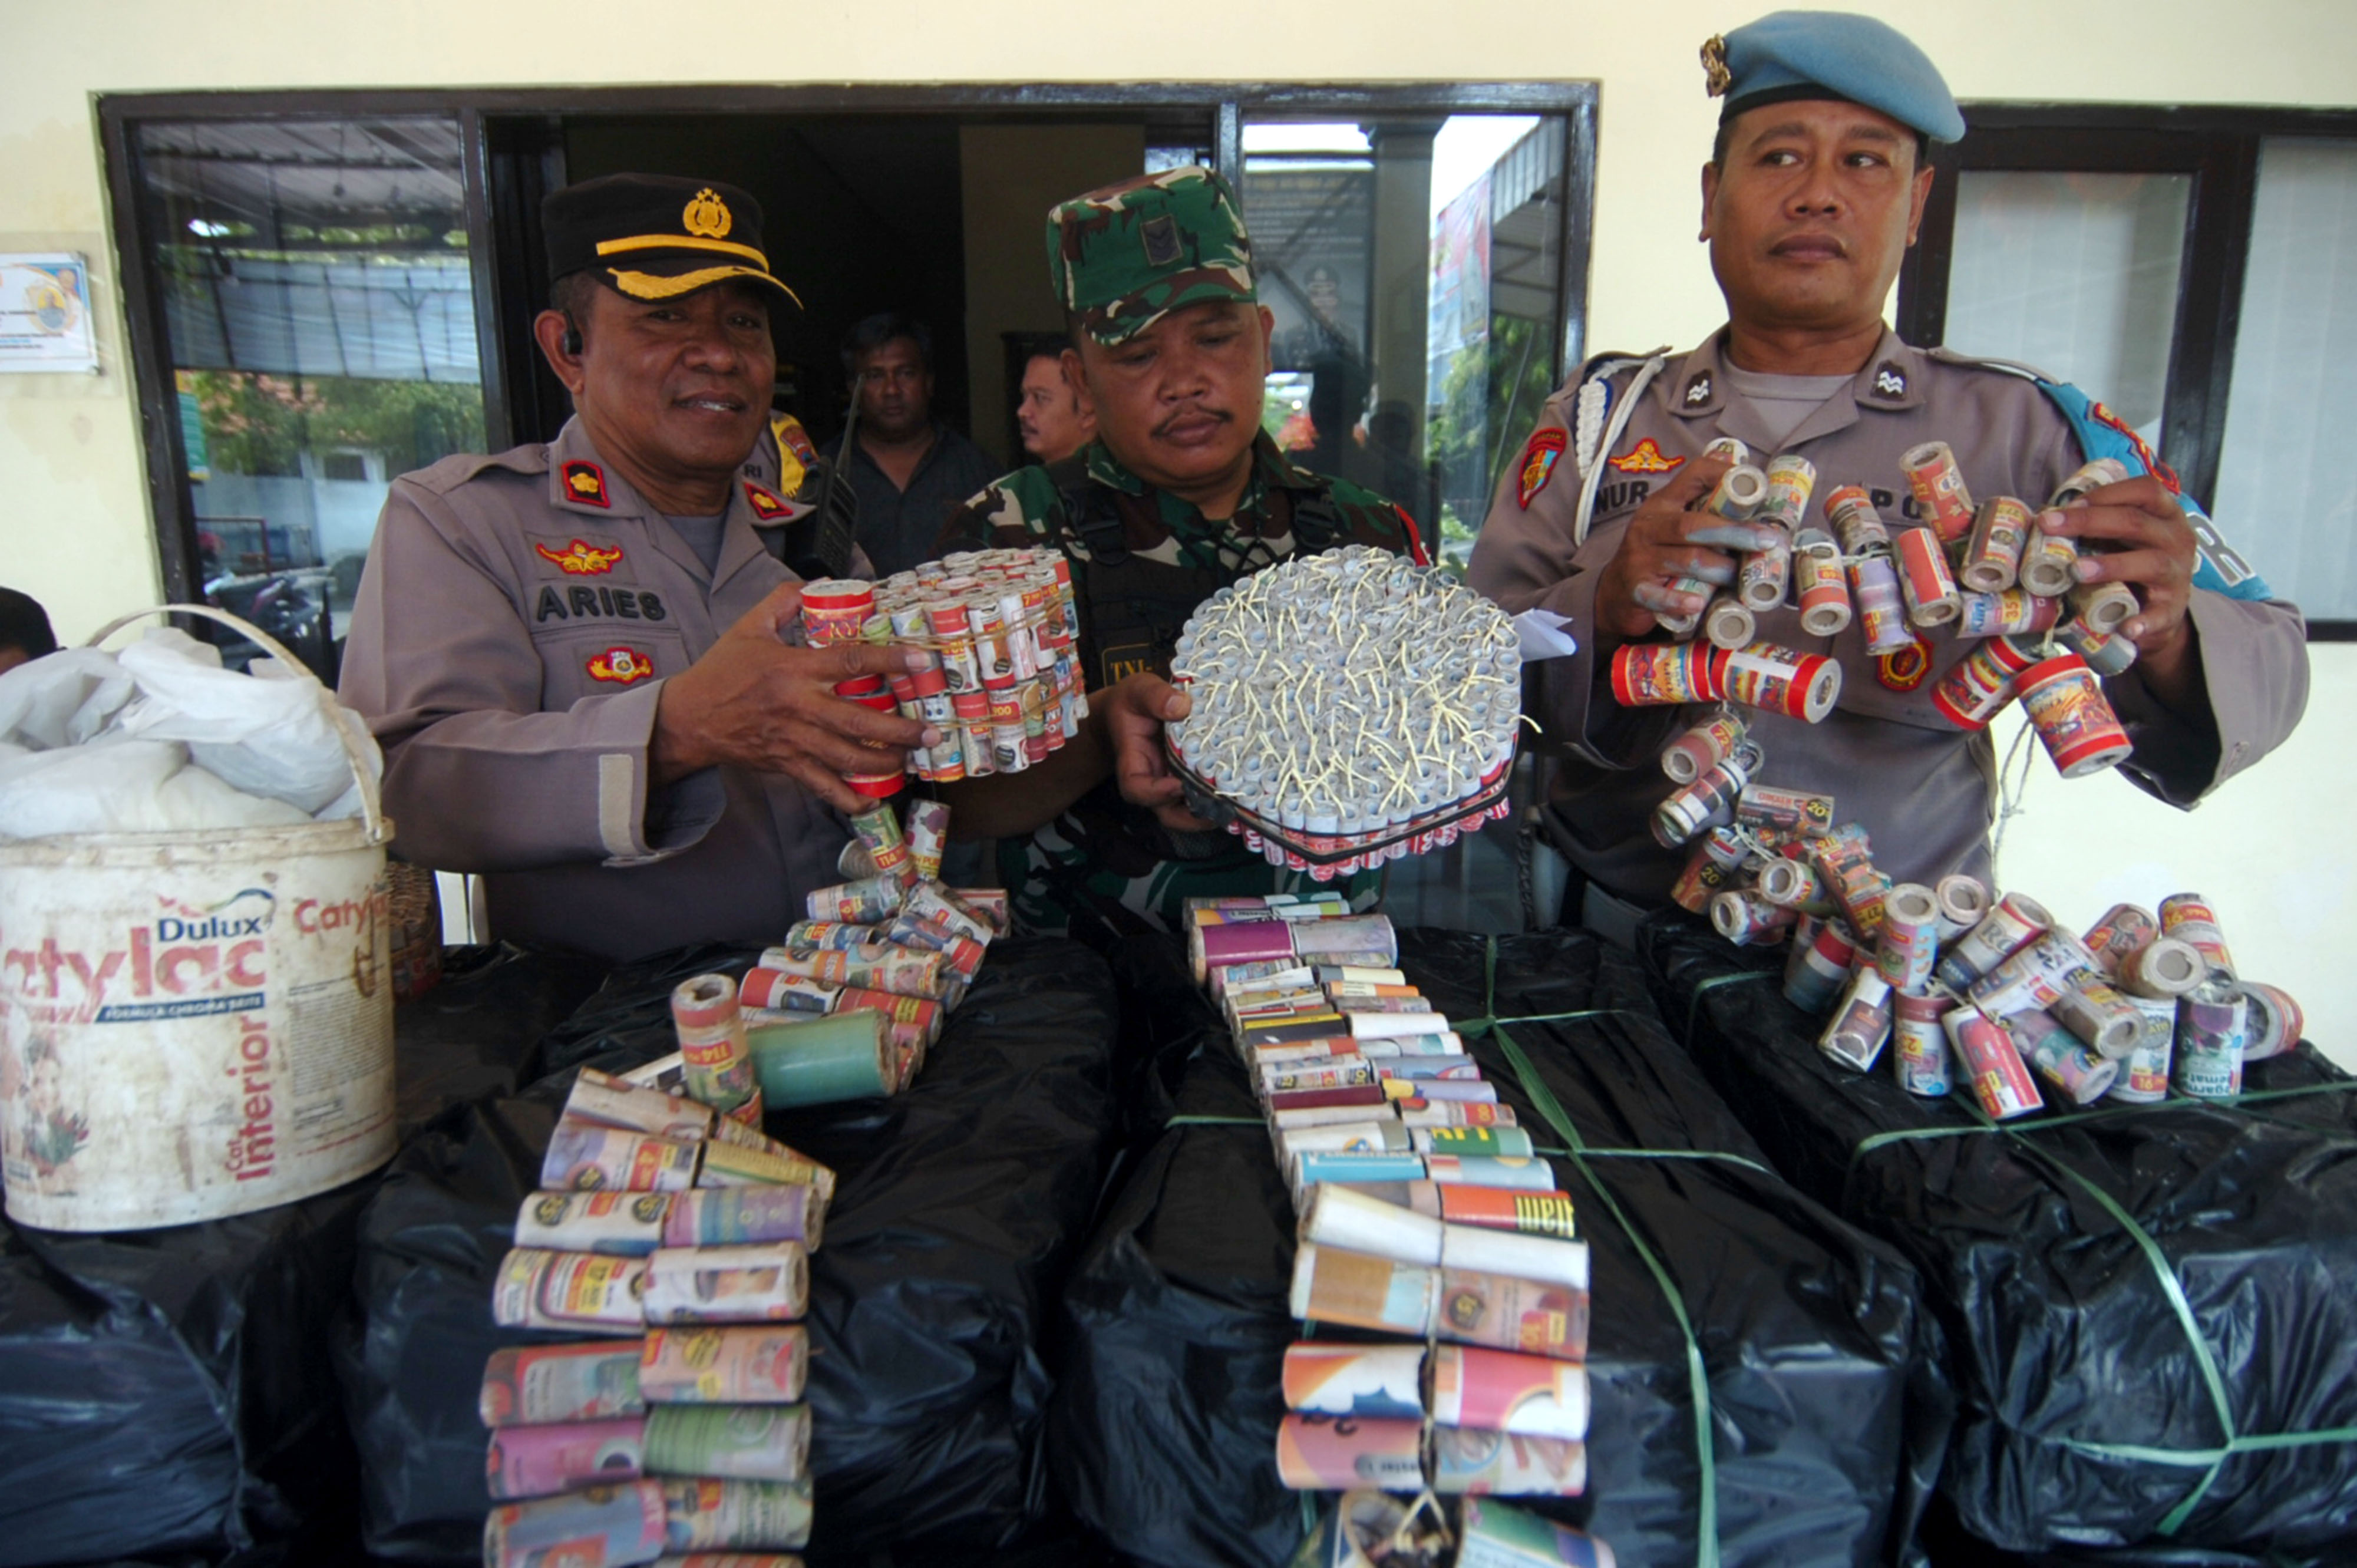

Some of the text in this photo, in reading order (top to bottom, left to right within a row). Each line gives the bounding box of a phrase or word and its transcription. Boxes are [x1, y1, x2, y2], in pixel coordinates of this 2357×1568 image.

[1595, 480, 1649, 516] NUR
[535, 585, 666, 622] ARIES
[158, 917, 262, 943] Dulux
[4, 926, 266, 1023] atylac
[229, 1015, 272, 1183] Interior
[225, 1137, 243, 1171] Cat
